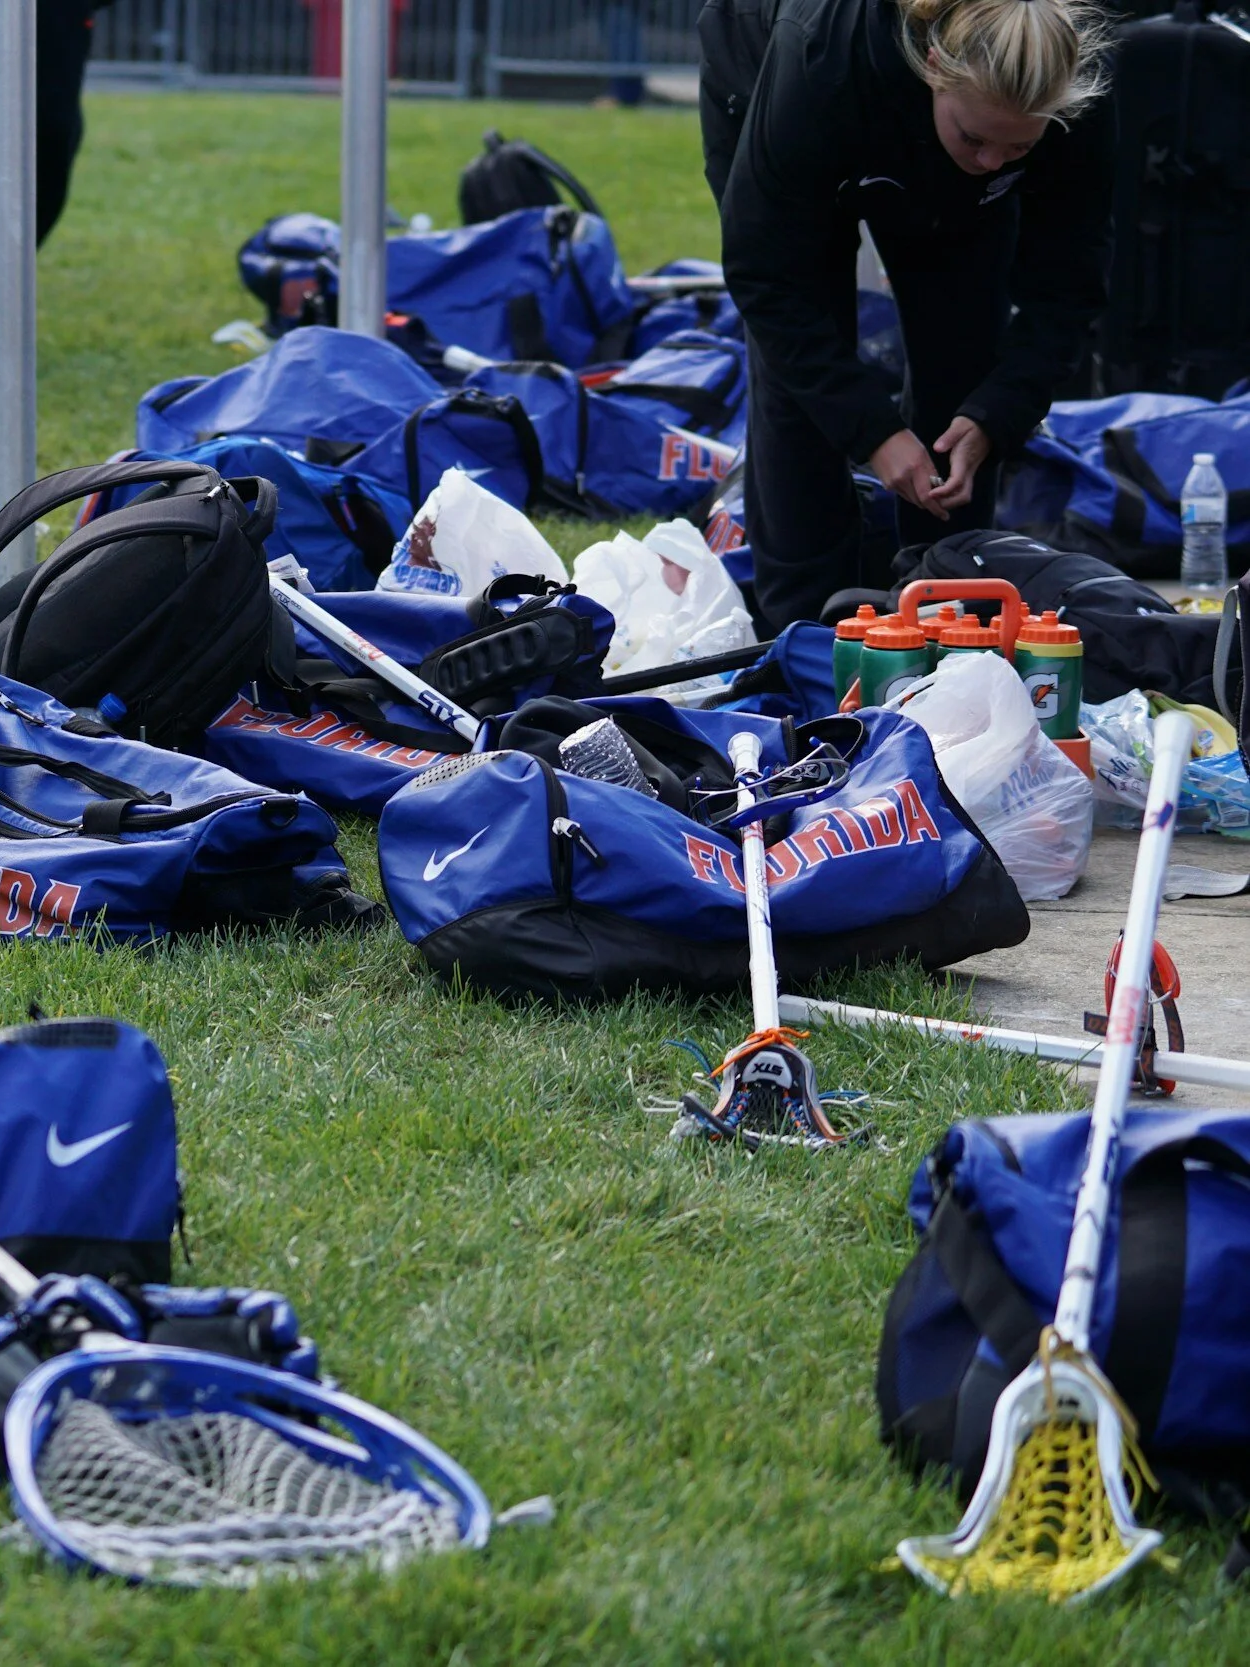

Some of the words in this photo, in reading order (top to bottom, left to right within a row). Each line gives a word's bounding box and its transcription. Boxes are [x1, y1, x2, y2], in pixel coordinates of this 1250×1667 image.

[205, 693, 467, 770] FLORID
[417, 690, 467, 732] STX
[680, 778, 942, 895] FLORIDA
[752, 1062, 784, 1077] STX
